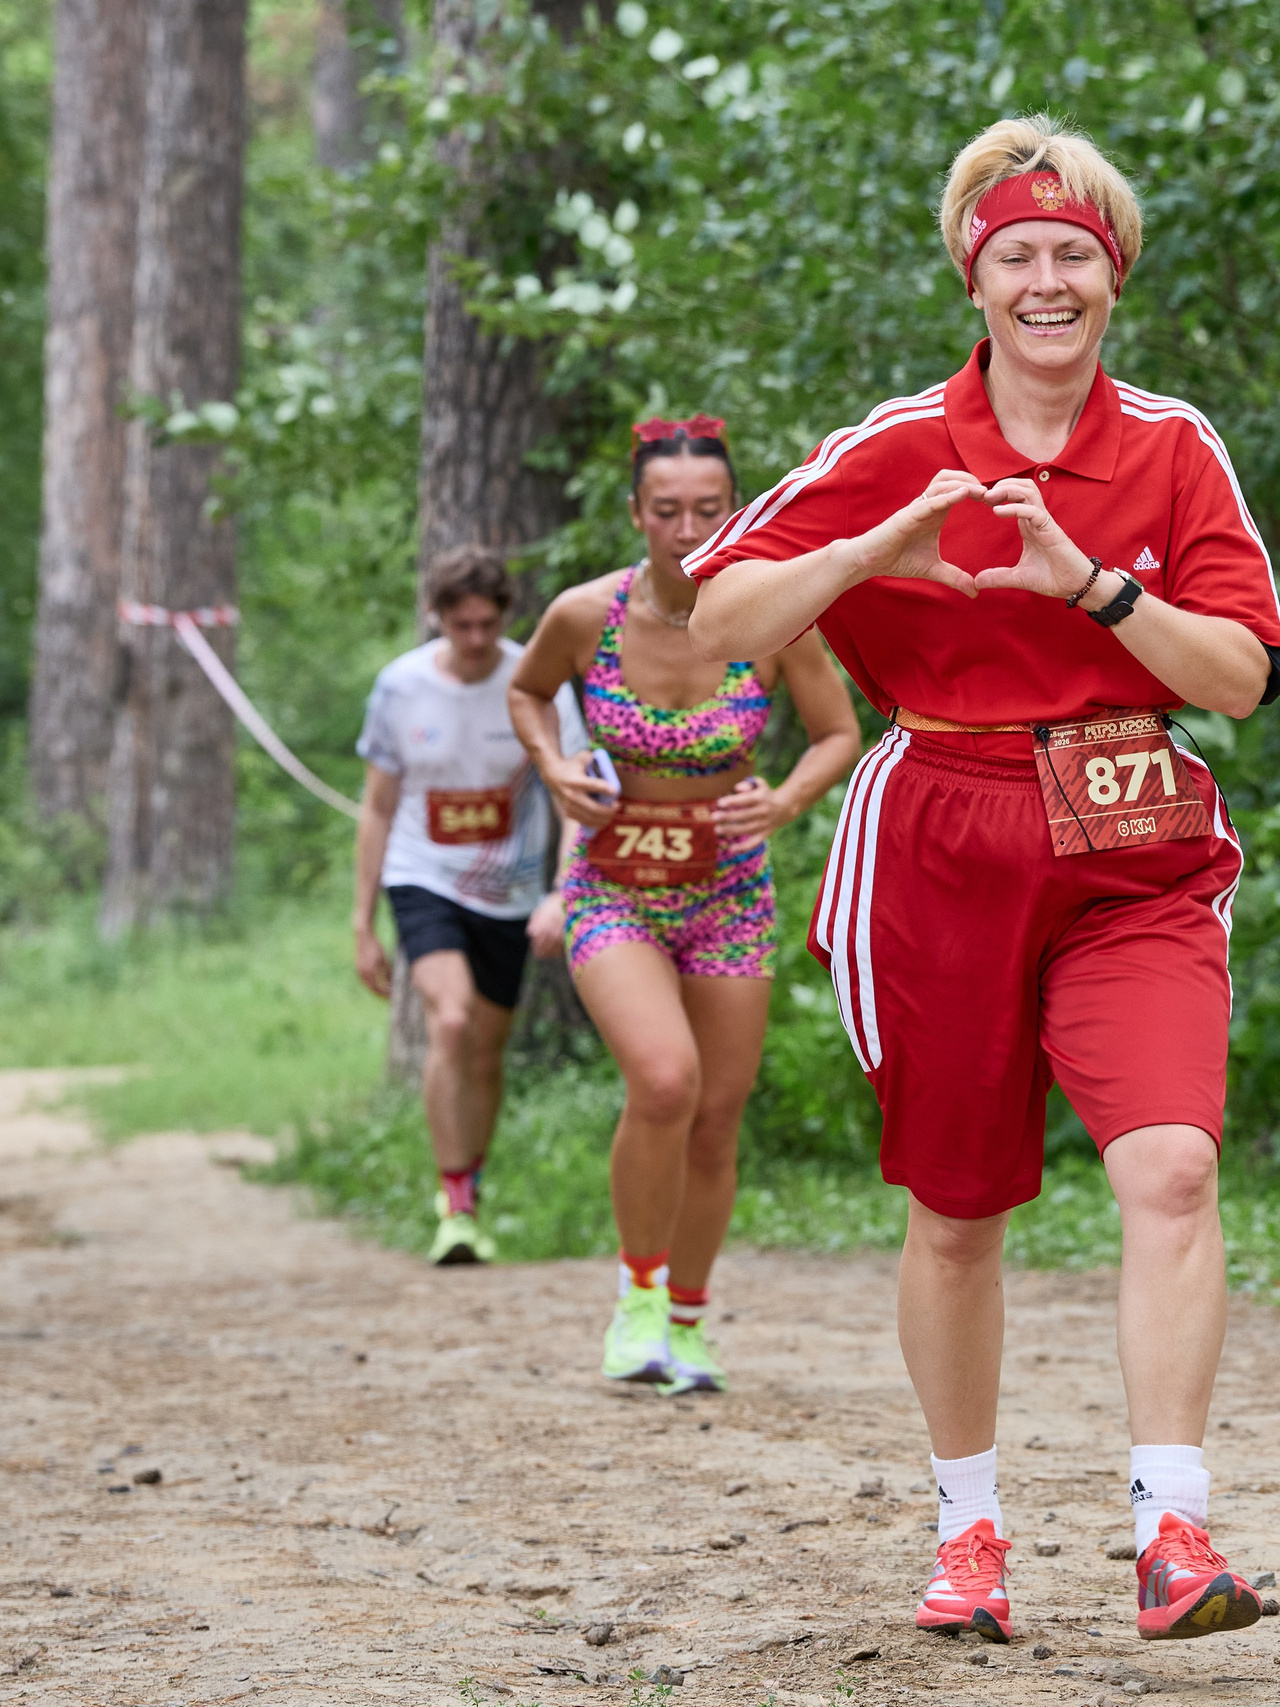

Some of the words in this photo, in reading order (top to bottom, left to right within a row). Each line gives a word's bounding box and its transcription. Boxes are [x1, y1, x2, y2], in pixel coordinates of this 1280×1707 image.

[1133, 561, 1160, 570] adidas
[1084, 723, 1117, 736] РЕТРО
[1120, 717, 1157, 731] КРОСС
[1085, 748, 1177, 806] 871
[1117, 821, 1129, 837] 6
[614, 825, 693, 861] 743
